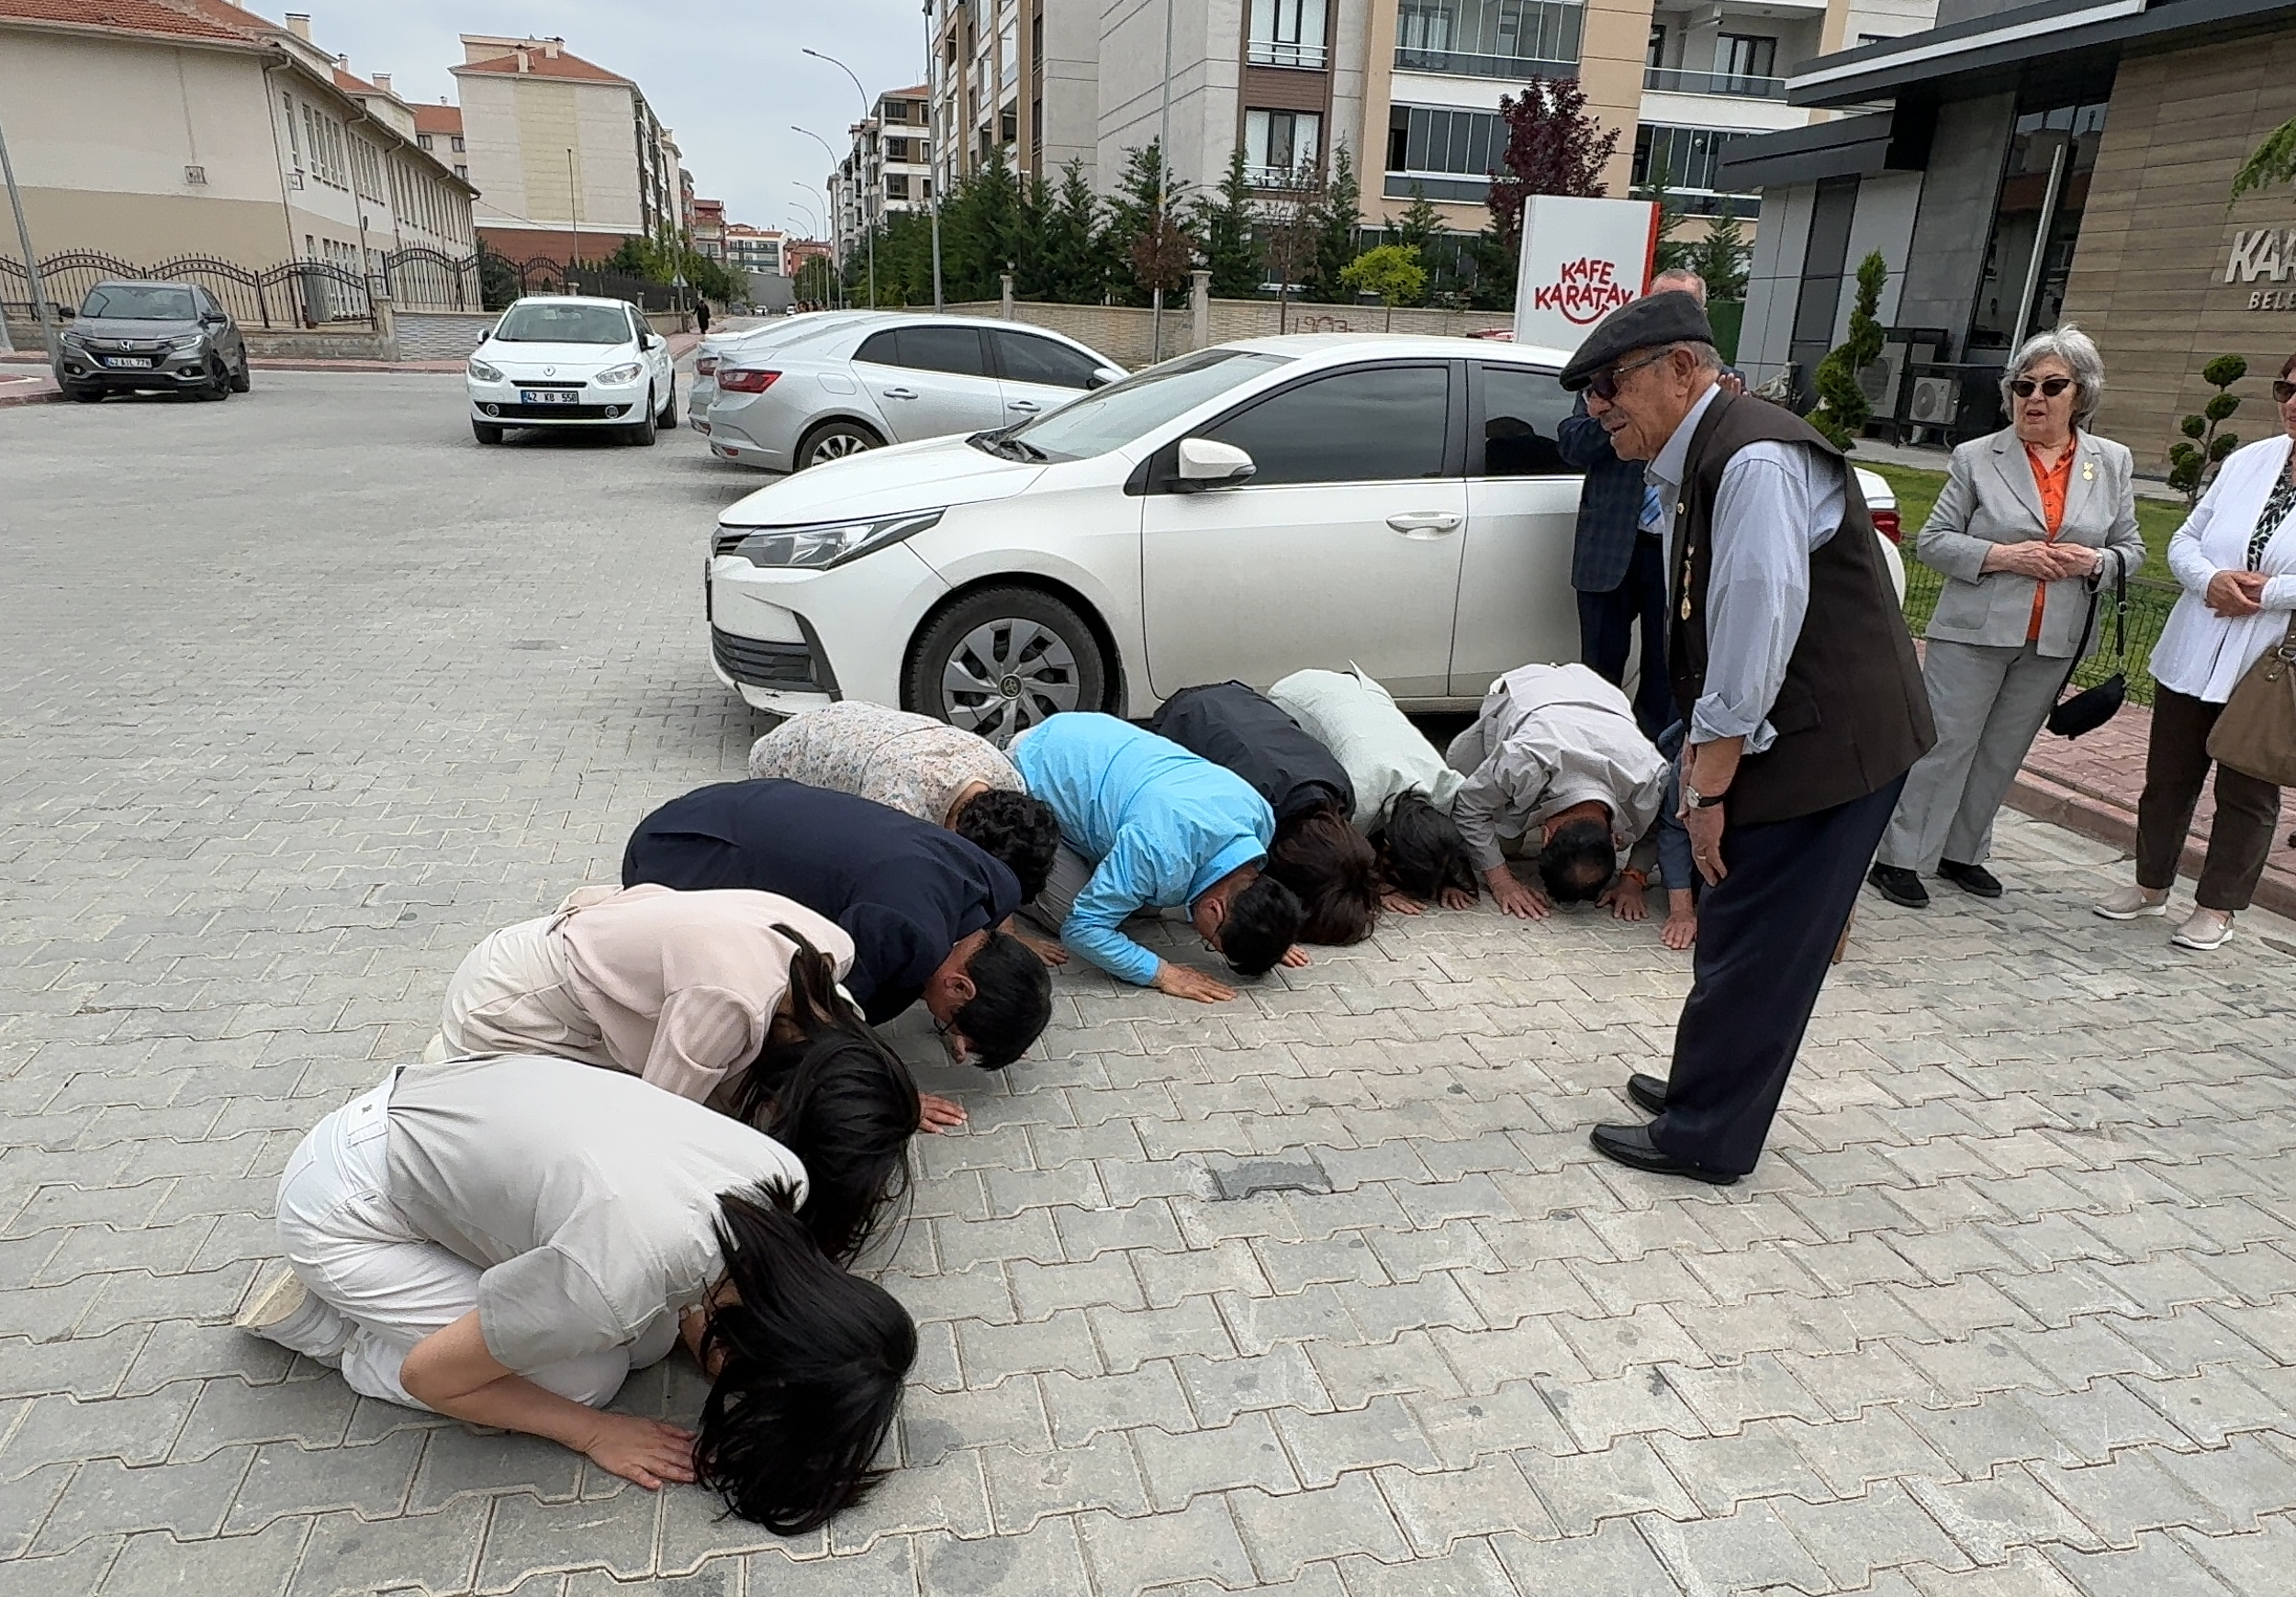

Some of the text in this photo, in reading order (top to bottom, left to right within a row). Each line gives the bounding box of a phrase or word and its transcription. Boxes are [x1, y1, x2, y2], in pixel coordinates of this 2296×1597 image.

[1562, 257, 1615, 285] KAFE
[1535, 283, 1634, 313] KARATAY
[527, 393, 537, 402] 42
[544, 393, 554, 402] KB
